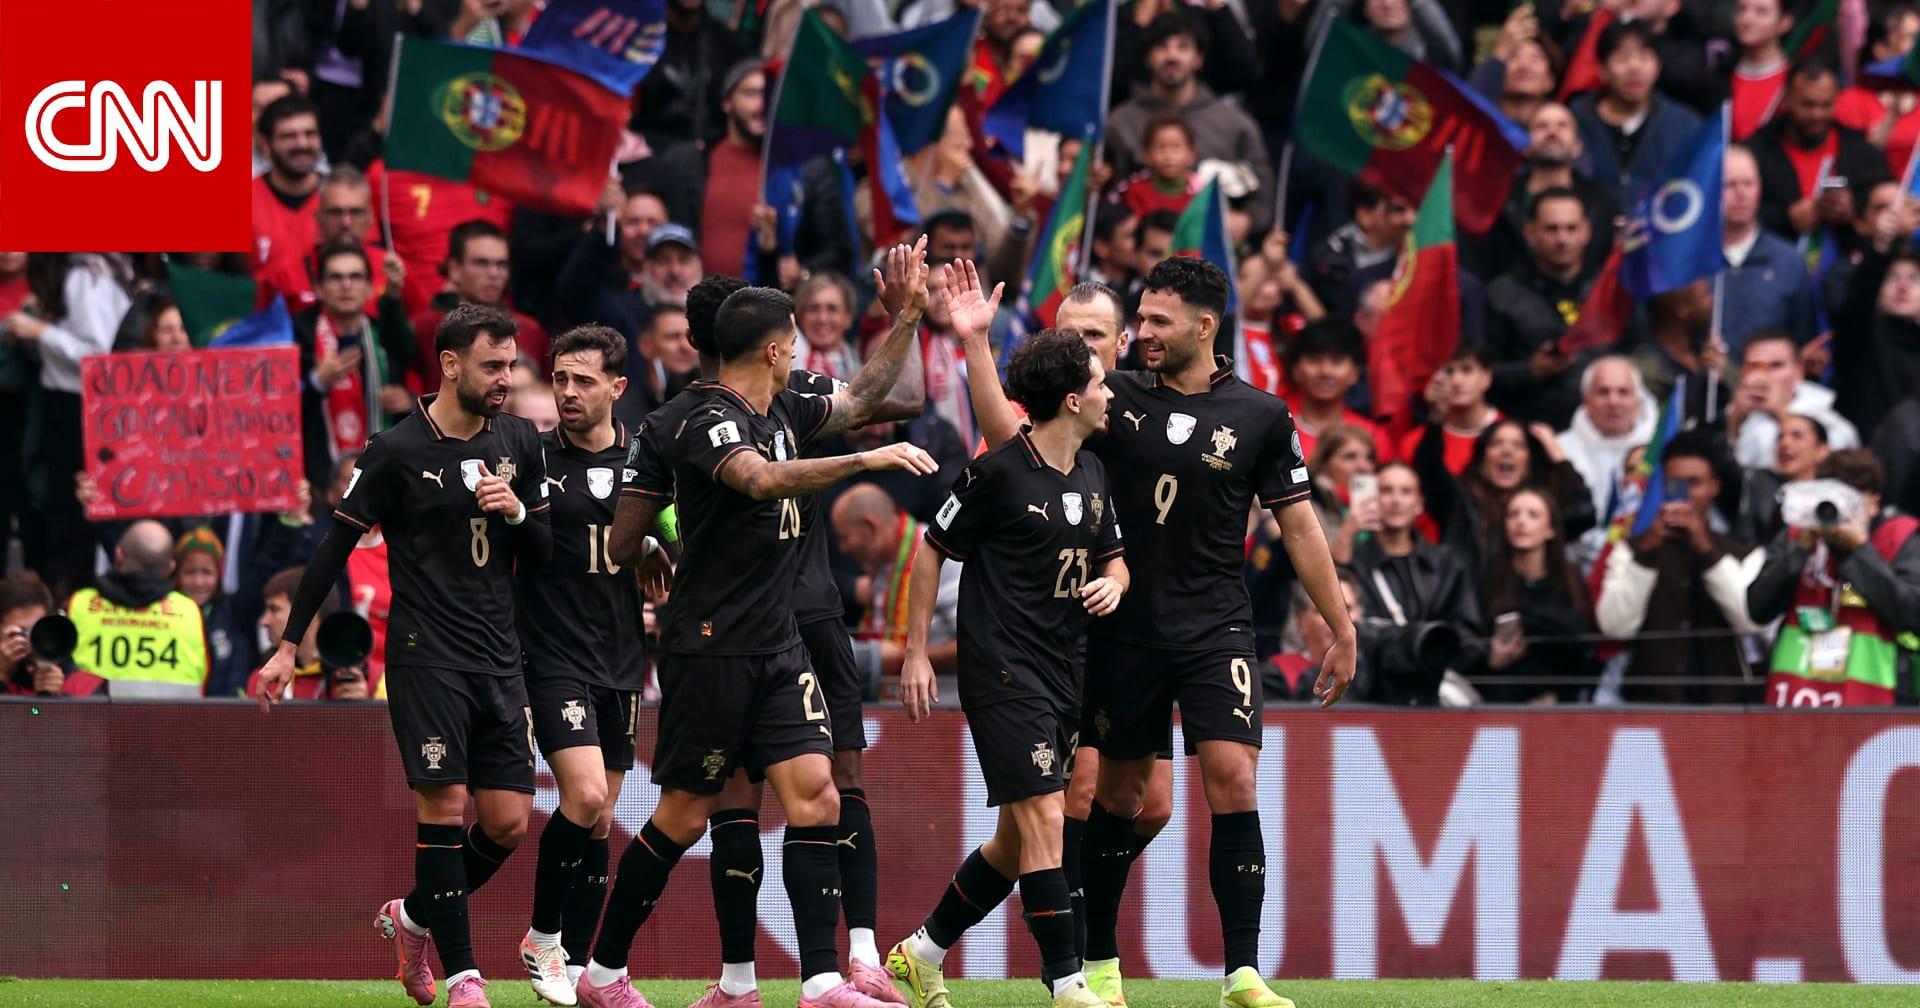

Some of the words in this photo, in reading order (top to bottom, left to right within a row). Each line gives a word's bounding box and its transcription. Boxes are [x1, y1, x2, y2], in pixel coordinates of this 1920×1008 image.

[778, 497, 801, 540] 20
[1154, 473, 1178, 525] 9
[470, 518, 490, 568] 8
[587, 524, 621, 575] 10
[1053, 548, 1089, 599] 23
[89, 635, 179, 669] 1054
[1230, 658, 1252, 706] 9
